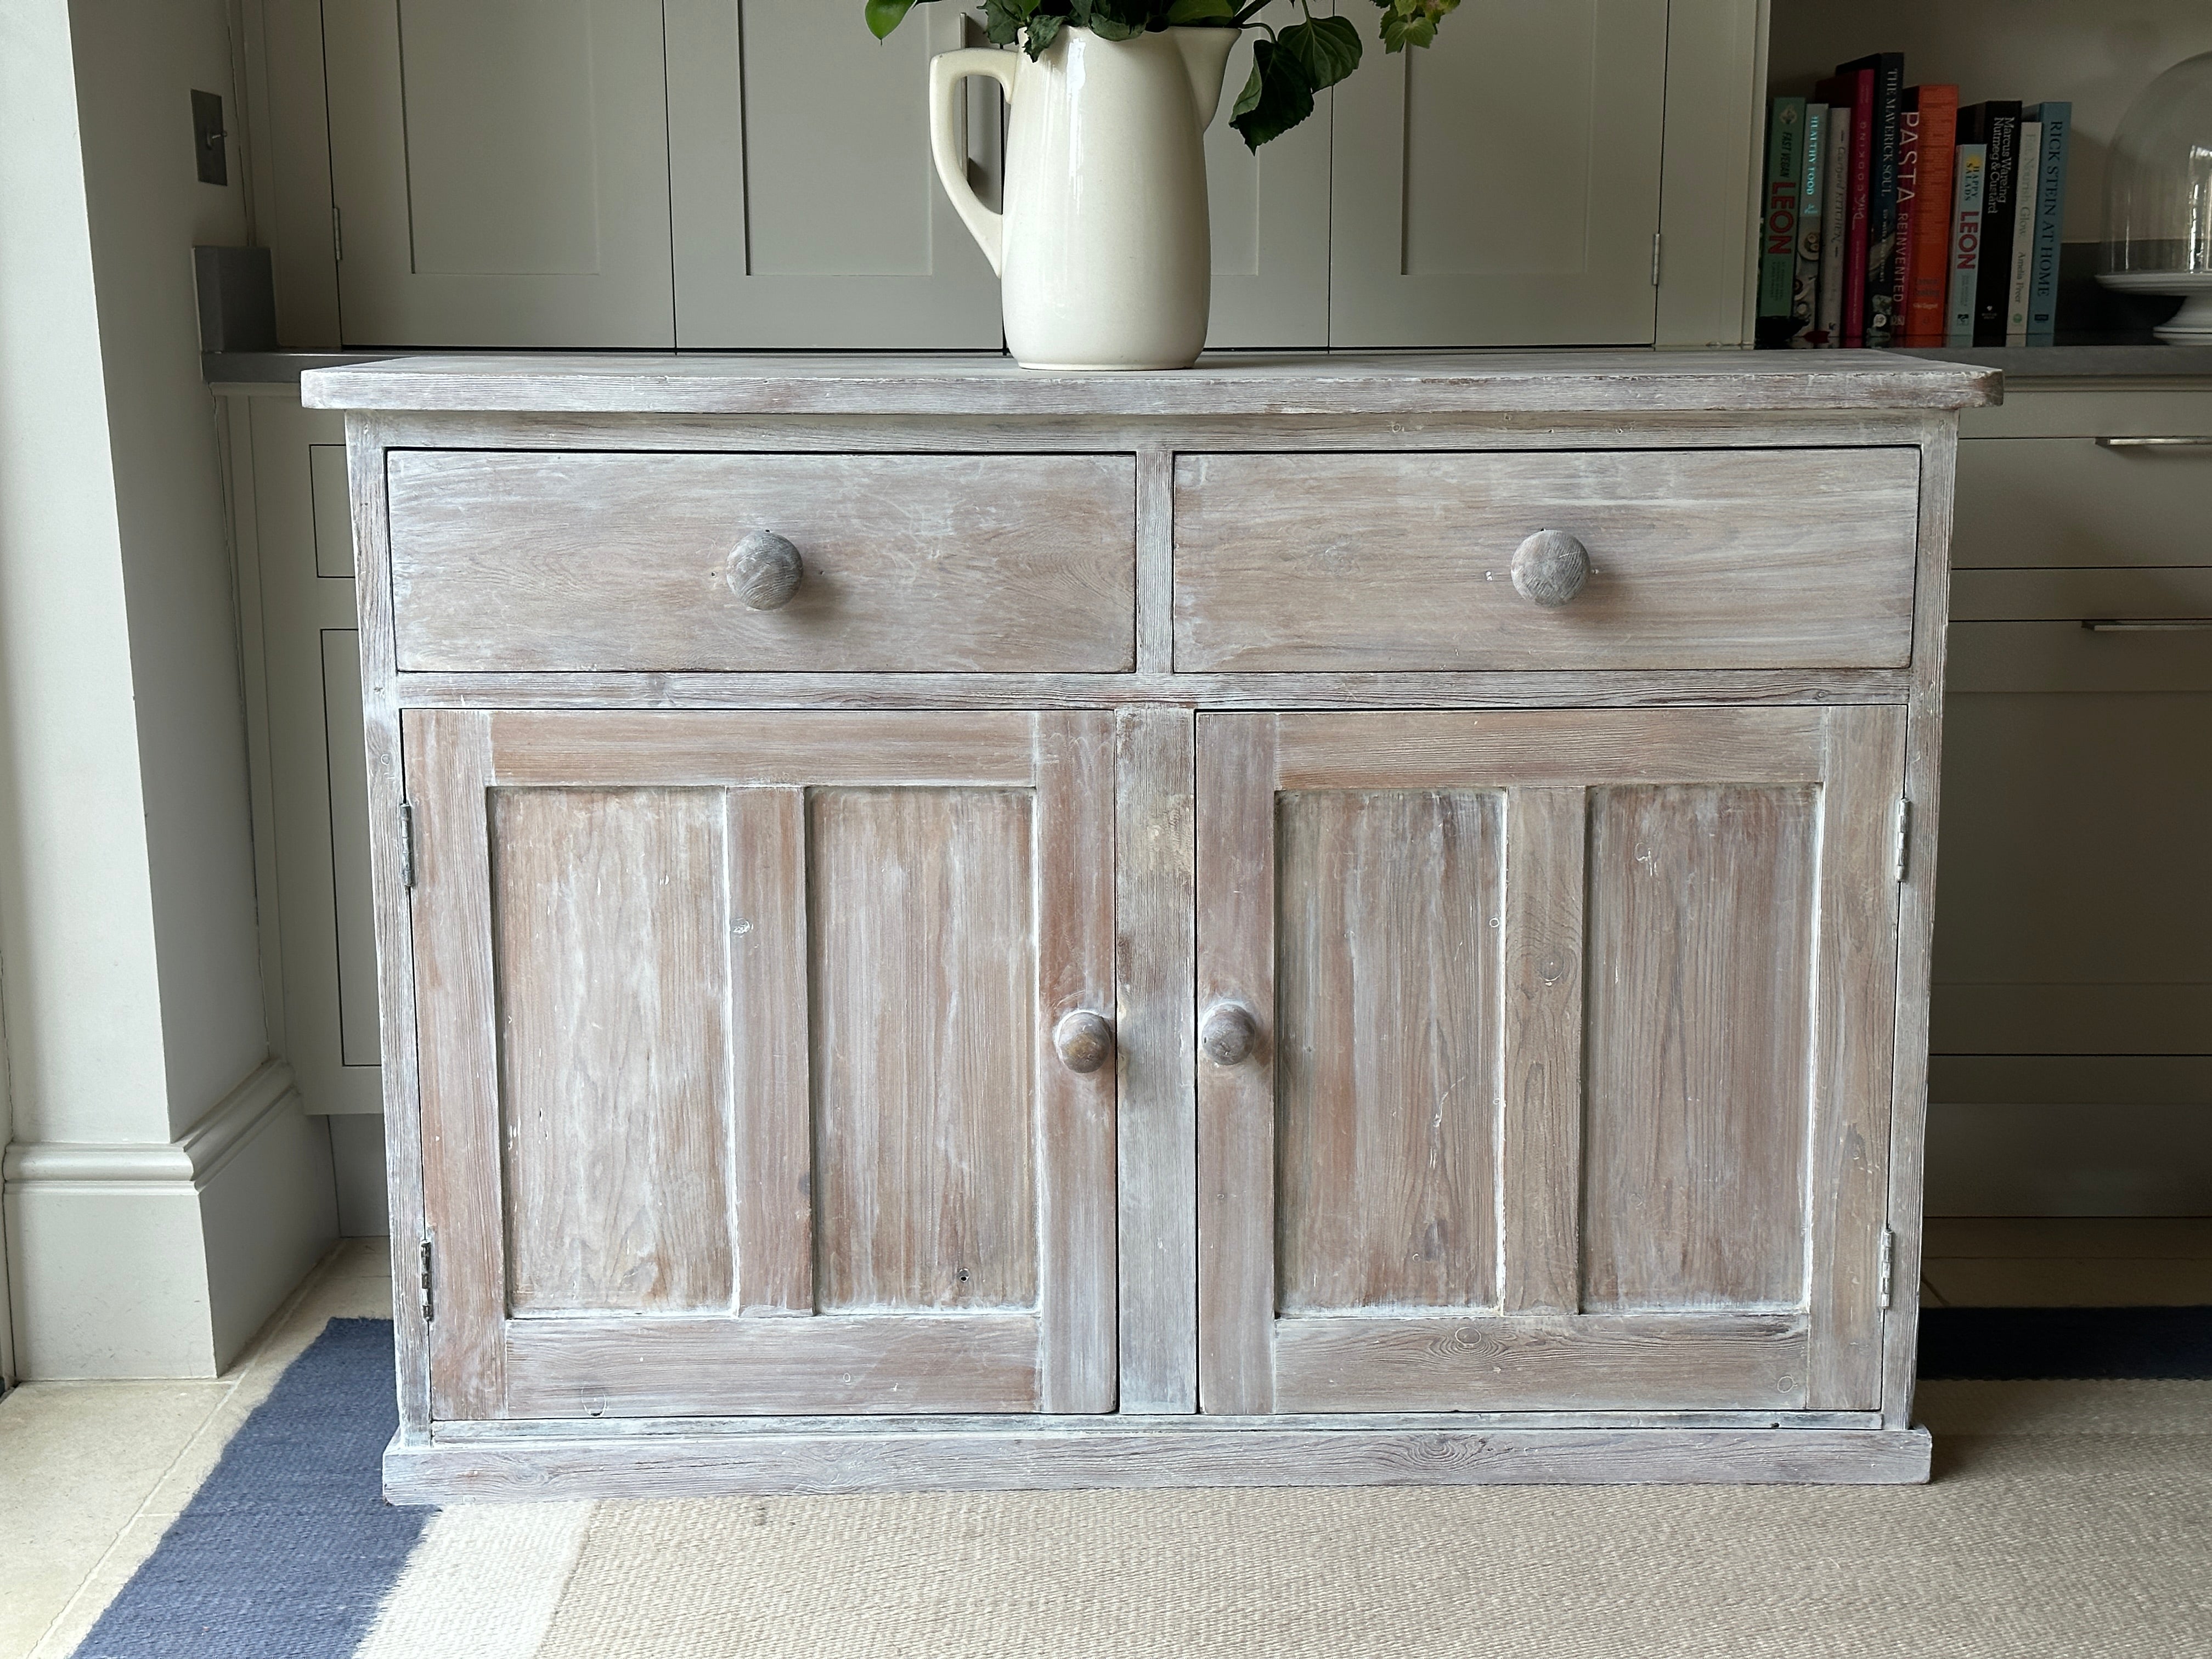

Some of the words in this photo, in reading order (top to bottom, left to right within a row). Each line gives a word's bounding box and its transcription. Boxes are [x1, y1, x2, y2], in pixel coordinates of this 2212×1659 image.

[1886, 68, 1898, 95] THE
[1782, 132, 1792, 151] FAST
[1809, 116, 1820, 163] HEALTHY
[1883, 98, 1896, 162] MAVERICK
[1990, 117, 2004, 160] Nutmeg
[2001, 117, 2015, 156] Marcus
[2049, 121, 2063, 161] RICK
[1780, 154, 1791, 178] VEGAN
[1857, 121, 1866, 191] COOKING
[1896, 111, 1920, 204] PASTA
[1991, 162, 2000, 171] &
[1807, 167, 1816, 195] FOOD
[1881, 165, 1892, 197] SOUL
[1971, 166, 1979, 198] HAPPY
[1988, 172, 1999, 214] Custard
[1997, 158, 2011, 203] Wareing
[2044, 166, 2058, 216] STEIN
[1768, 182, 1796, 254] LEON
[1831, 193, 1844, 242] KITCHEN
[2042, 221, 2055, 242] AT
[1893, 213, 1908, 302] REINVENTED
[1957, 211, 1979, 269] LEON
[2016, 252, 2025, 280] Amelia
[2038, 247, 2052, 297] HOME
[2015, 283, 2023, 303] Freer
